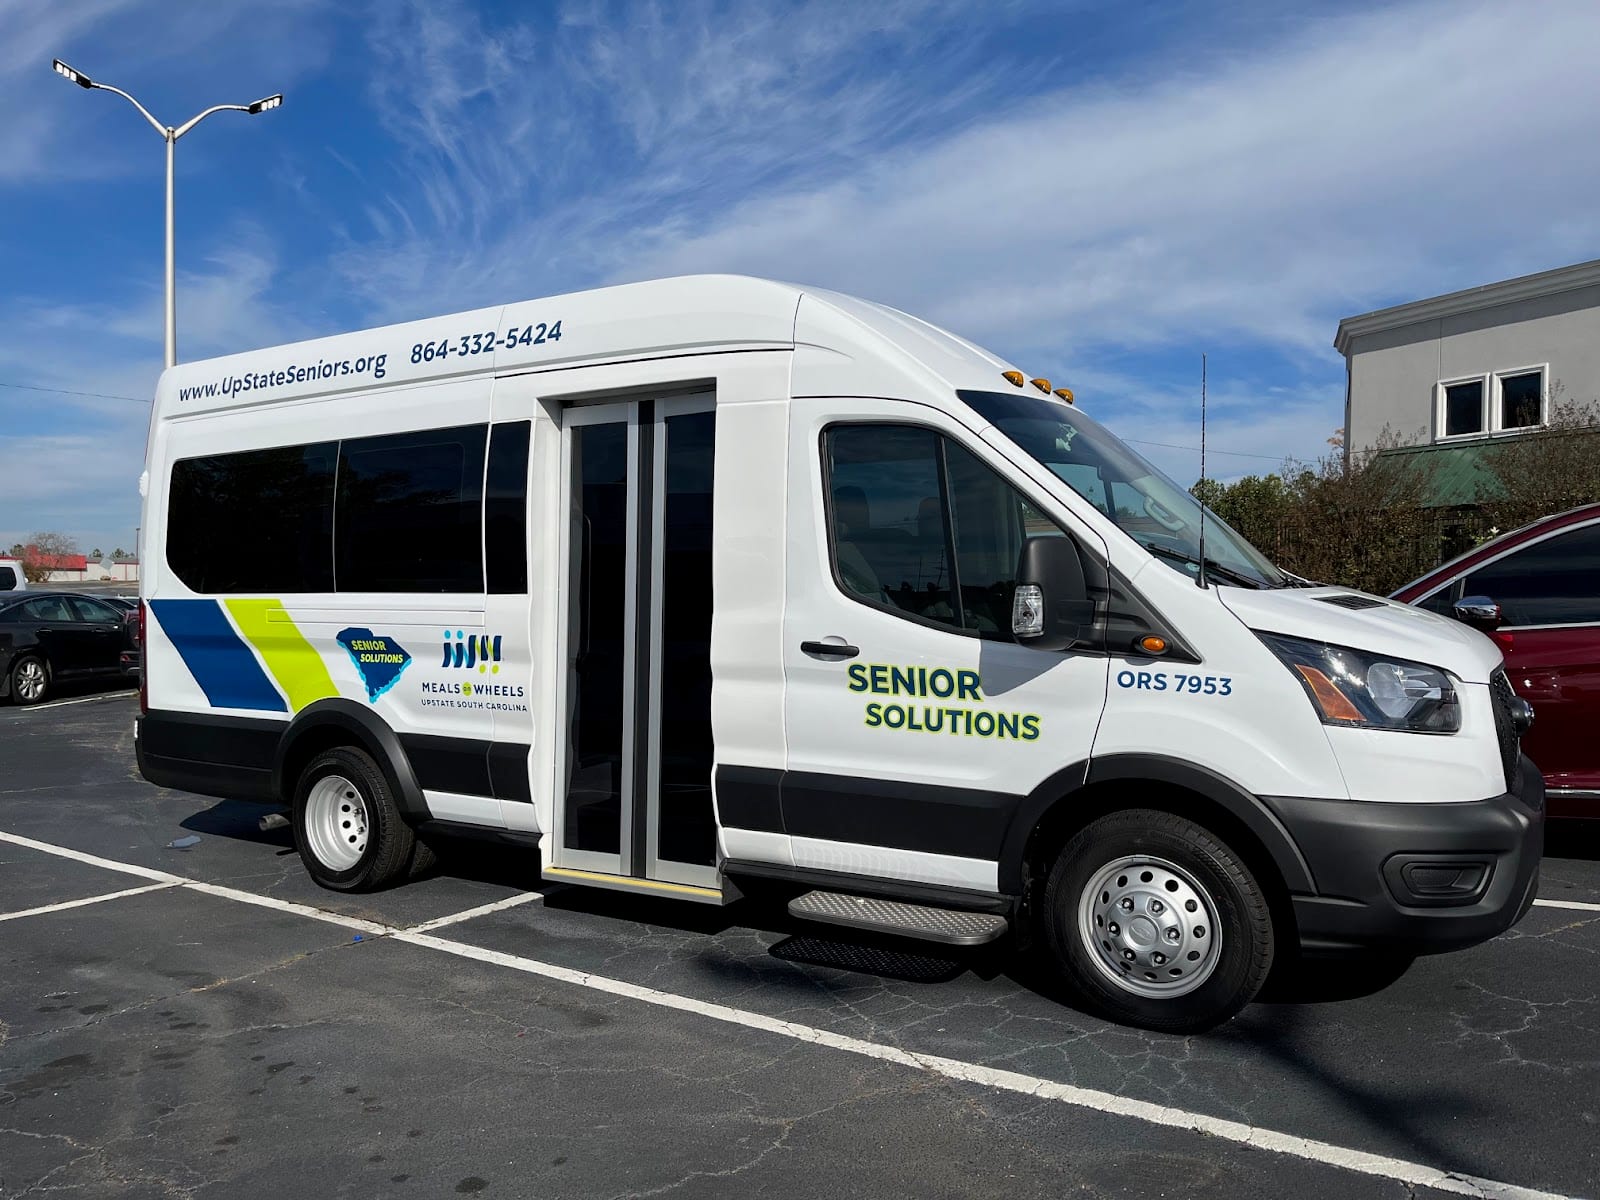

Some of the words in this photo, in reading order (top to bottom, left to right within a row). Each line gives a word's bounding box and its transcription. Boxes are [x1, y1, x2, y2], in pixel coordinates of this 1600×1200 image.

[410, 320, 563, 364] 864-332-5424
[179, 353, 387, 401] www.UpStateSeniors.org
[351, 640, 386, 651] SENIOR
[360, 654, 403, 663] SOLUTIONS
[422, 682, 460, 694] MEALS
[473, 683, 524, 697] WHEELS
[848, 663, 983, 701] SENIOR
[1117, 670, 1167, 691] ORS
[1174, 673, 1232, 696] 7953
[421, 699, 454, 708] UPSTATE
[457, 701, 483, 709] SOUTH
[485, 702, 528, 712] CAROLINA
[865, 702, 1041, 741] SOLUTIONS
